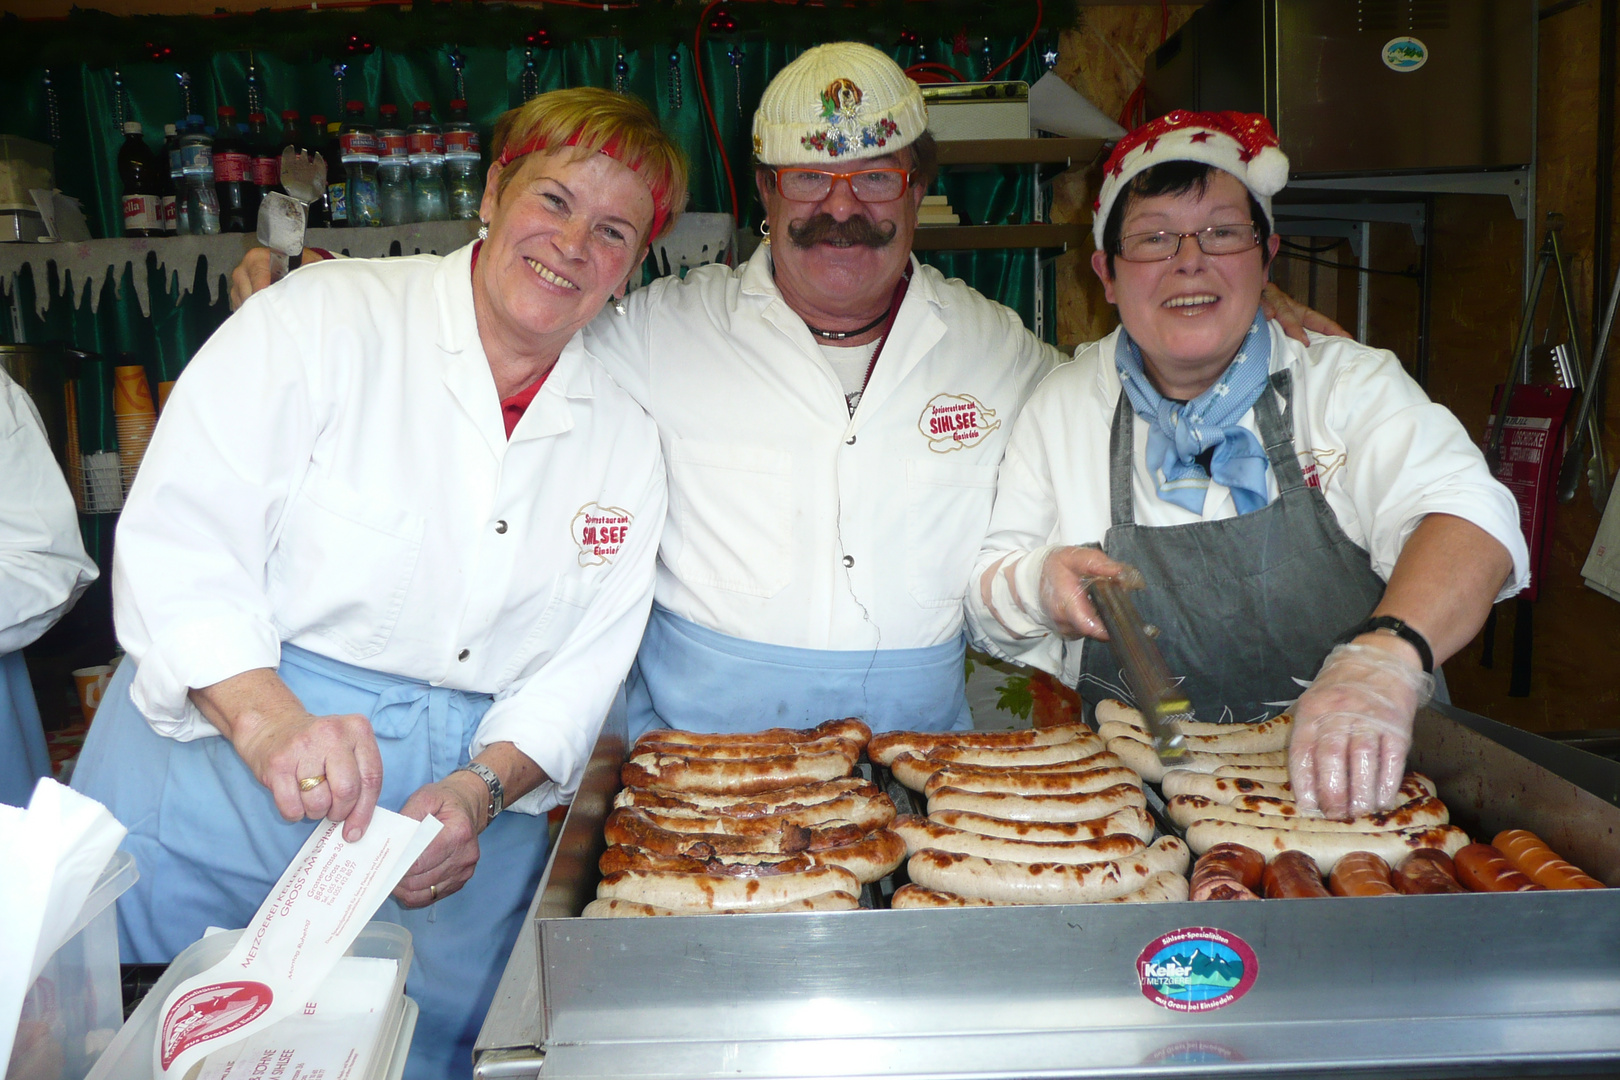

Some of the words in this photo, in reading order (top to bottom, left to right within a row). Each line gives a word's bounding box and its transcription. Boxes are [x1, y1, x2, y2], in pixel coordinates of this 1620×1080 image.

[929, 411, 978, 434] SIHLSEE
[334, 842, 344, 852] 36
[280, 877, 306, 917] GROSS
[303, 856, 318, 876] AM
[313, 883, 328, 901] 8841
[324, 864, 341, 882] Gross
[241, 903, 280, 969] METZGEREI
[1162, 931, 1229, 945] Sihlsee-Spezialitäten
[288, 950, 301, 980] Montag
[297, 919, 311, 949] Ruhetag
[1145, 963, 1193, 977] Keller
[1155, 996, 1167, 1006] aus
[1167, 1000, 1187, 1010] Gross
[1188, 1002, 1200, 1010] bei
[1200, 994, 1234, 1009] Einsiedeln
[202, 1029, 228, 1041] Gross
[271, 1049, 295, 1075] SIHLSEE
